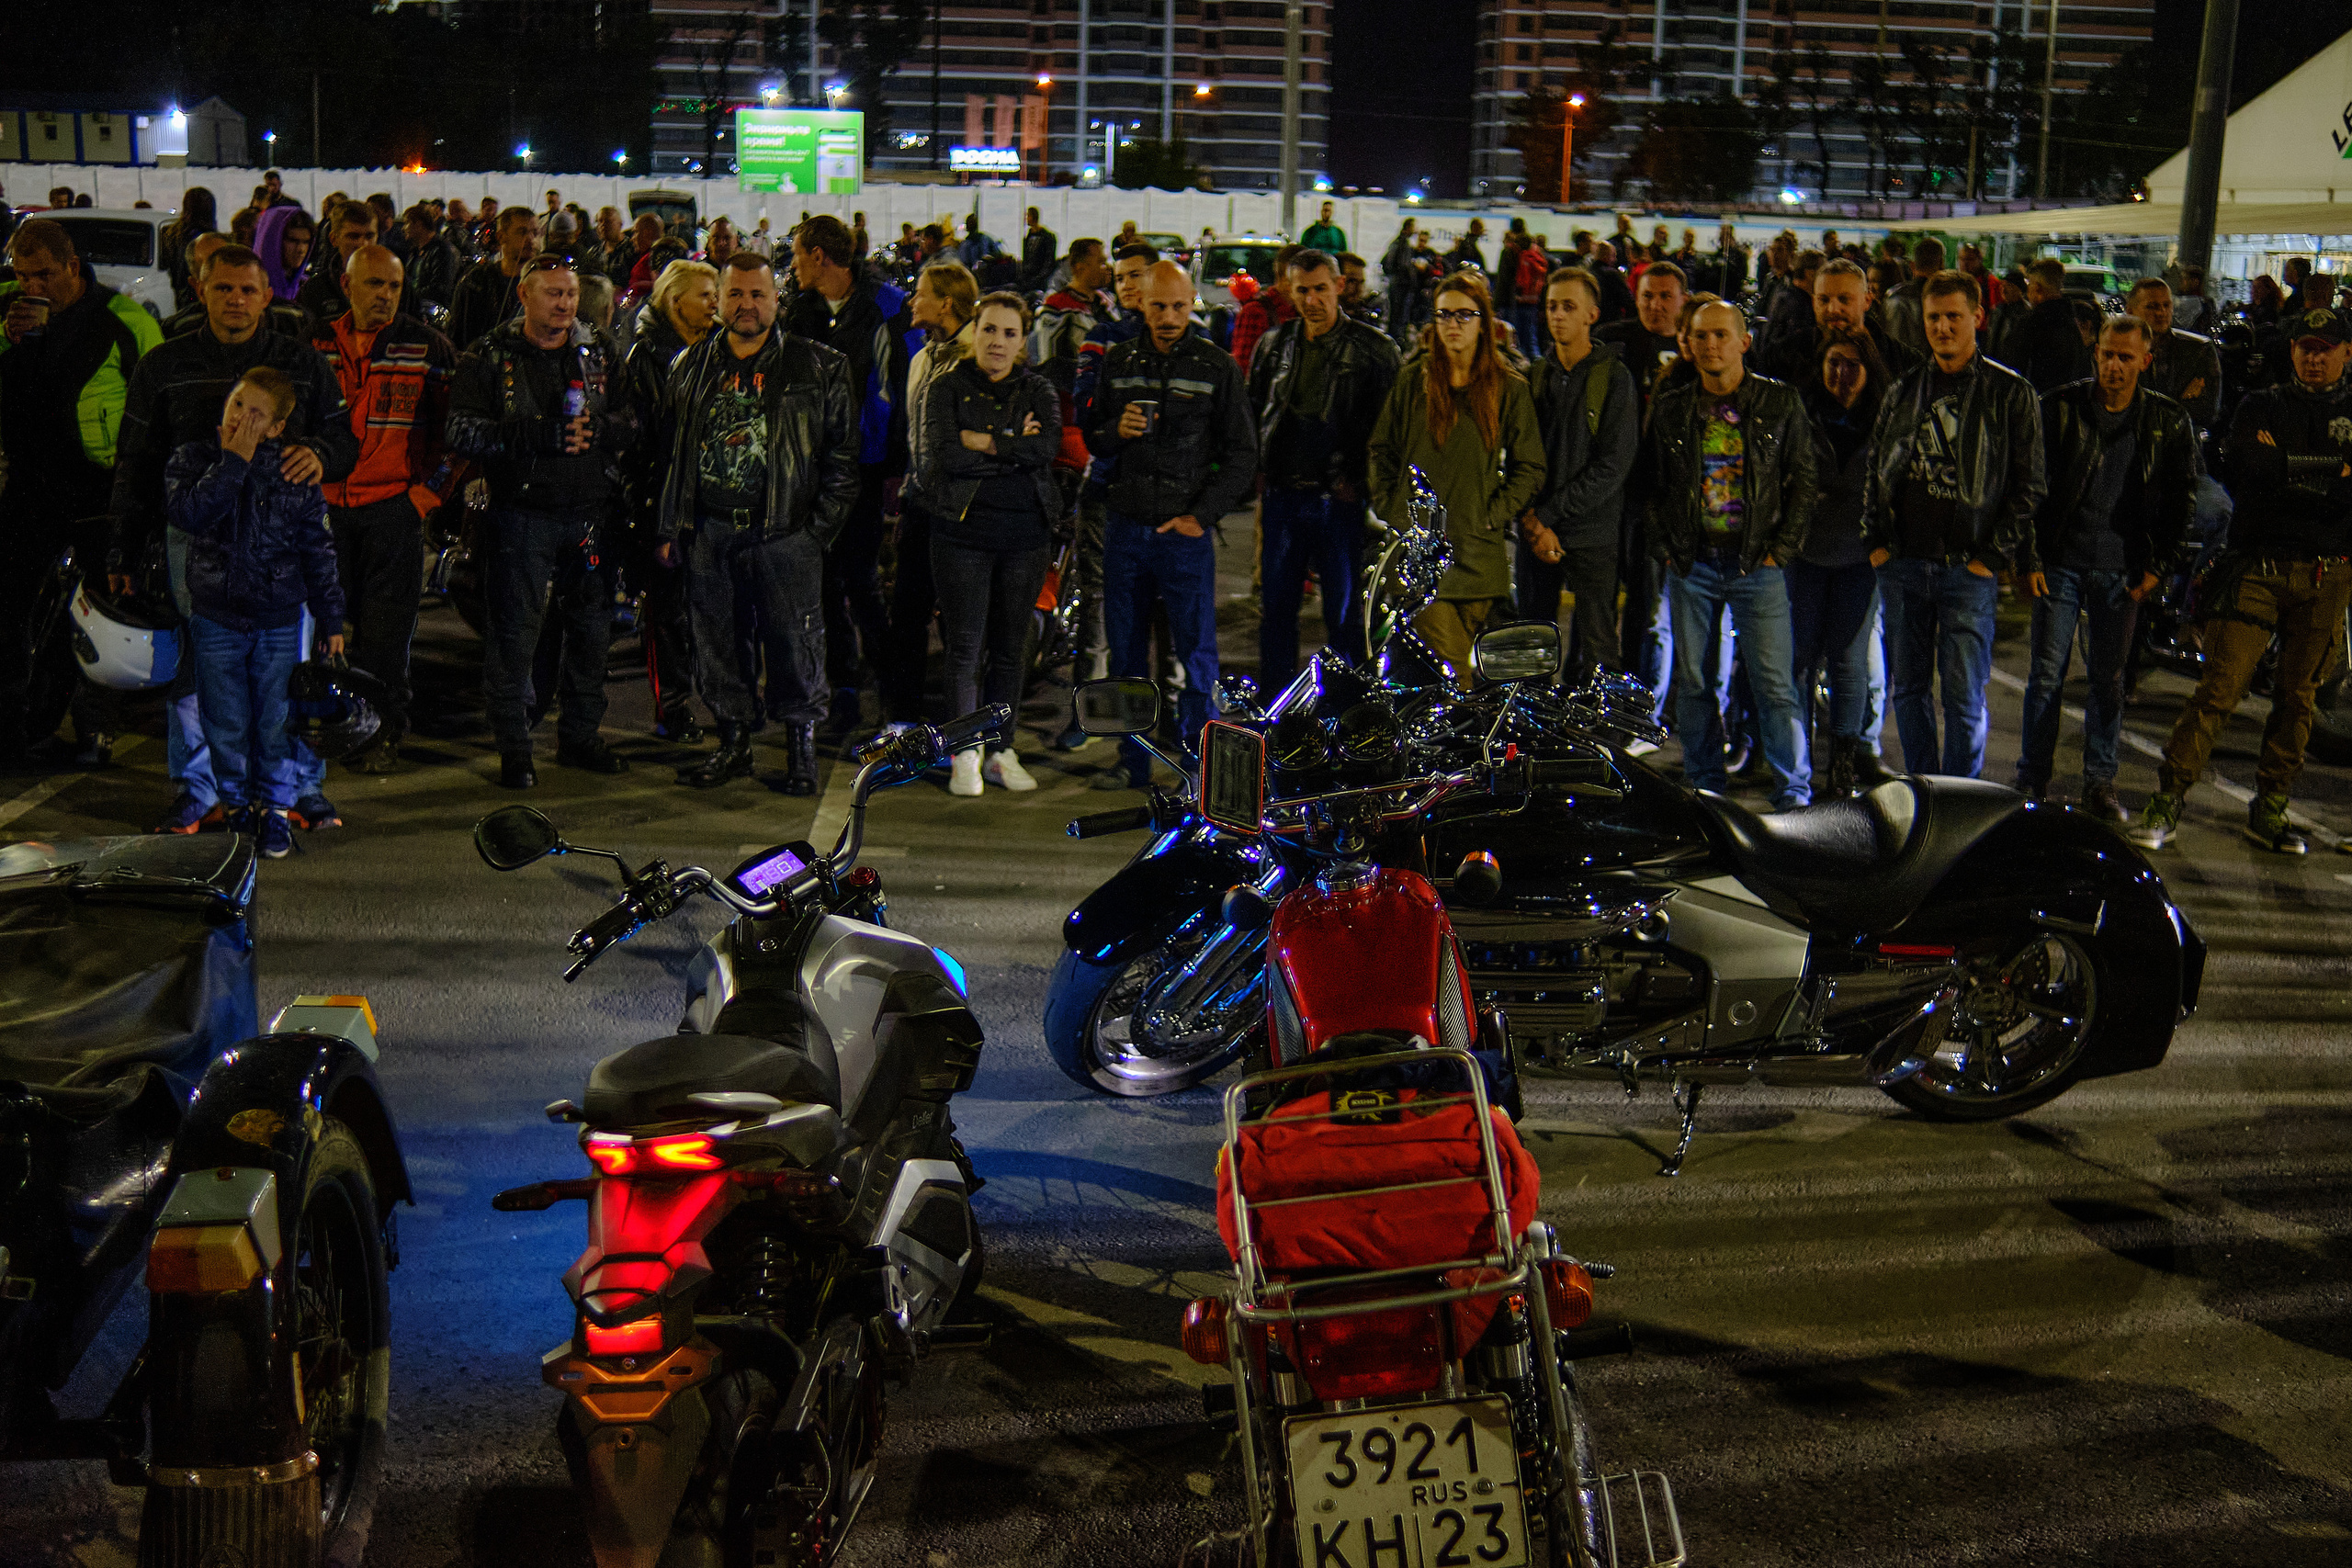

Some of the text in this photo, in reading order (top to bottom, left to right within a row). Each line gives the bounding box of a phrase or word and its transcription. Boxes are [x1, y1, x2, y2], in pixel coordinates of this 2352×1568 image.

[1319, 1416, 1479, 1488] 3921
[1412, 1480, 1468, 1506] RUS
[1432, 1502, 1510, 1567] 23
